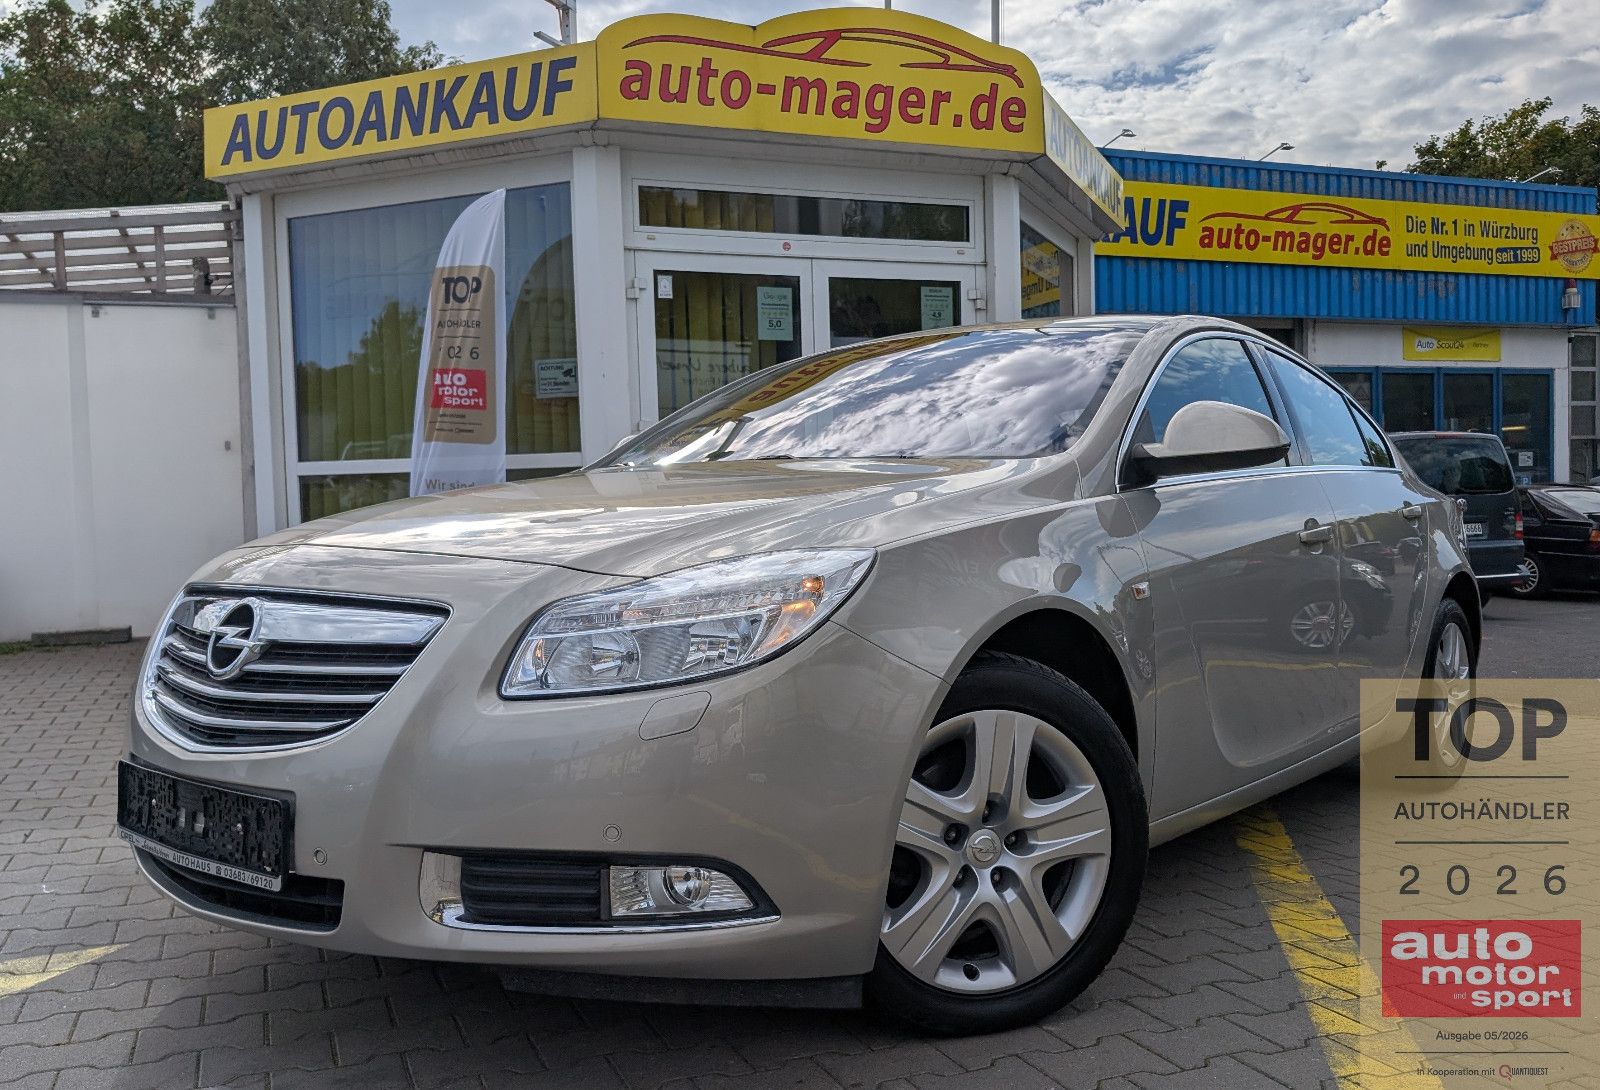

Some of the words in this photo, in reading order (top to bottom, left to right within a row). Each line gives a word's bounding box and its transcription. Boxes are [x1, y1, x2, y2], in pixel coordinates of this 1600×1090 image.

[619, 57, 1027, 133] auto-mager.de
[221, 56, 577, 166] AUTOANKAUF
[1199, 224, 1392, 260] auto-mager.de
[1405, 215, 1427, 234] Die
[1431, 216, 1449, 236] Nr.
[1452, 218, 1458, 236] 1
[1464, 218, 1475, 237] in
[1480, 220, 1539, 245] Würzburg
[1405, 240, 1428, 258] und
[1432, 240, 1494, 265] Umgebung
[1496, 249, 1514, 263] seit
[1516, 249, 1539, 263] 1999
[1552, 237, 1595, 255] BESTPREIS
[442, 275, 482, 304] TOP
[768, 319, 782, 328] 5,0
[1416, 339, 1434, 349] Auto
[172, 852, 211, 873] AUTOHAUS
